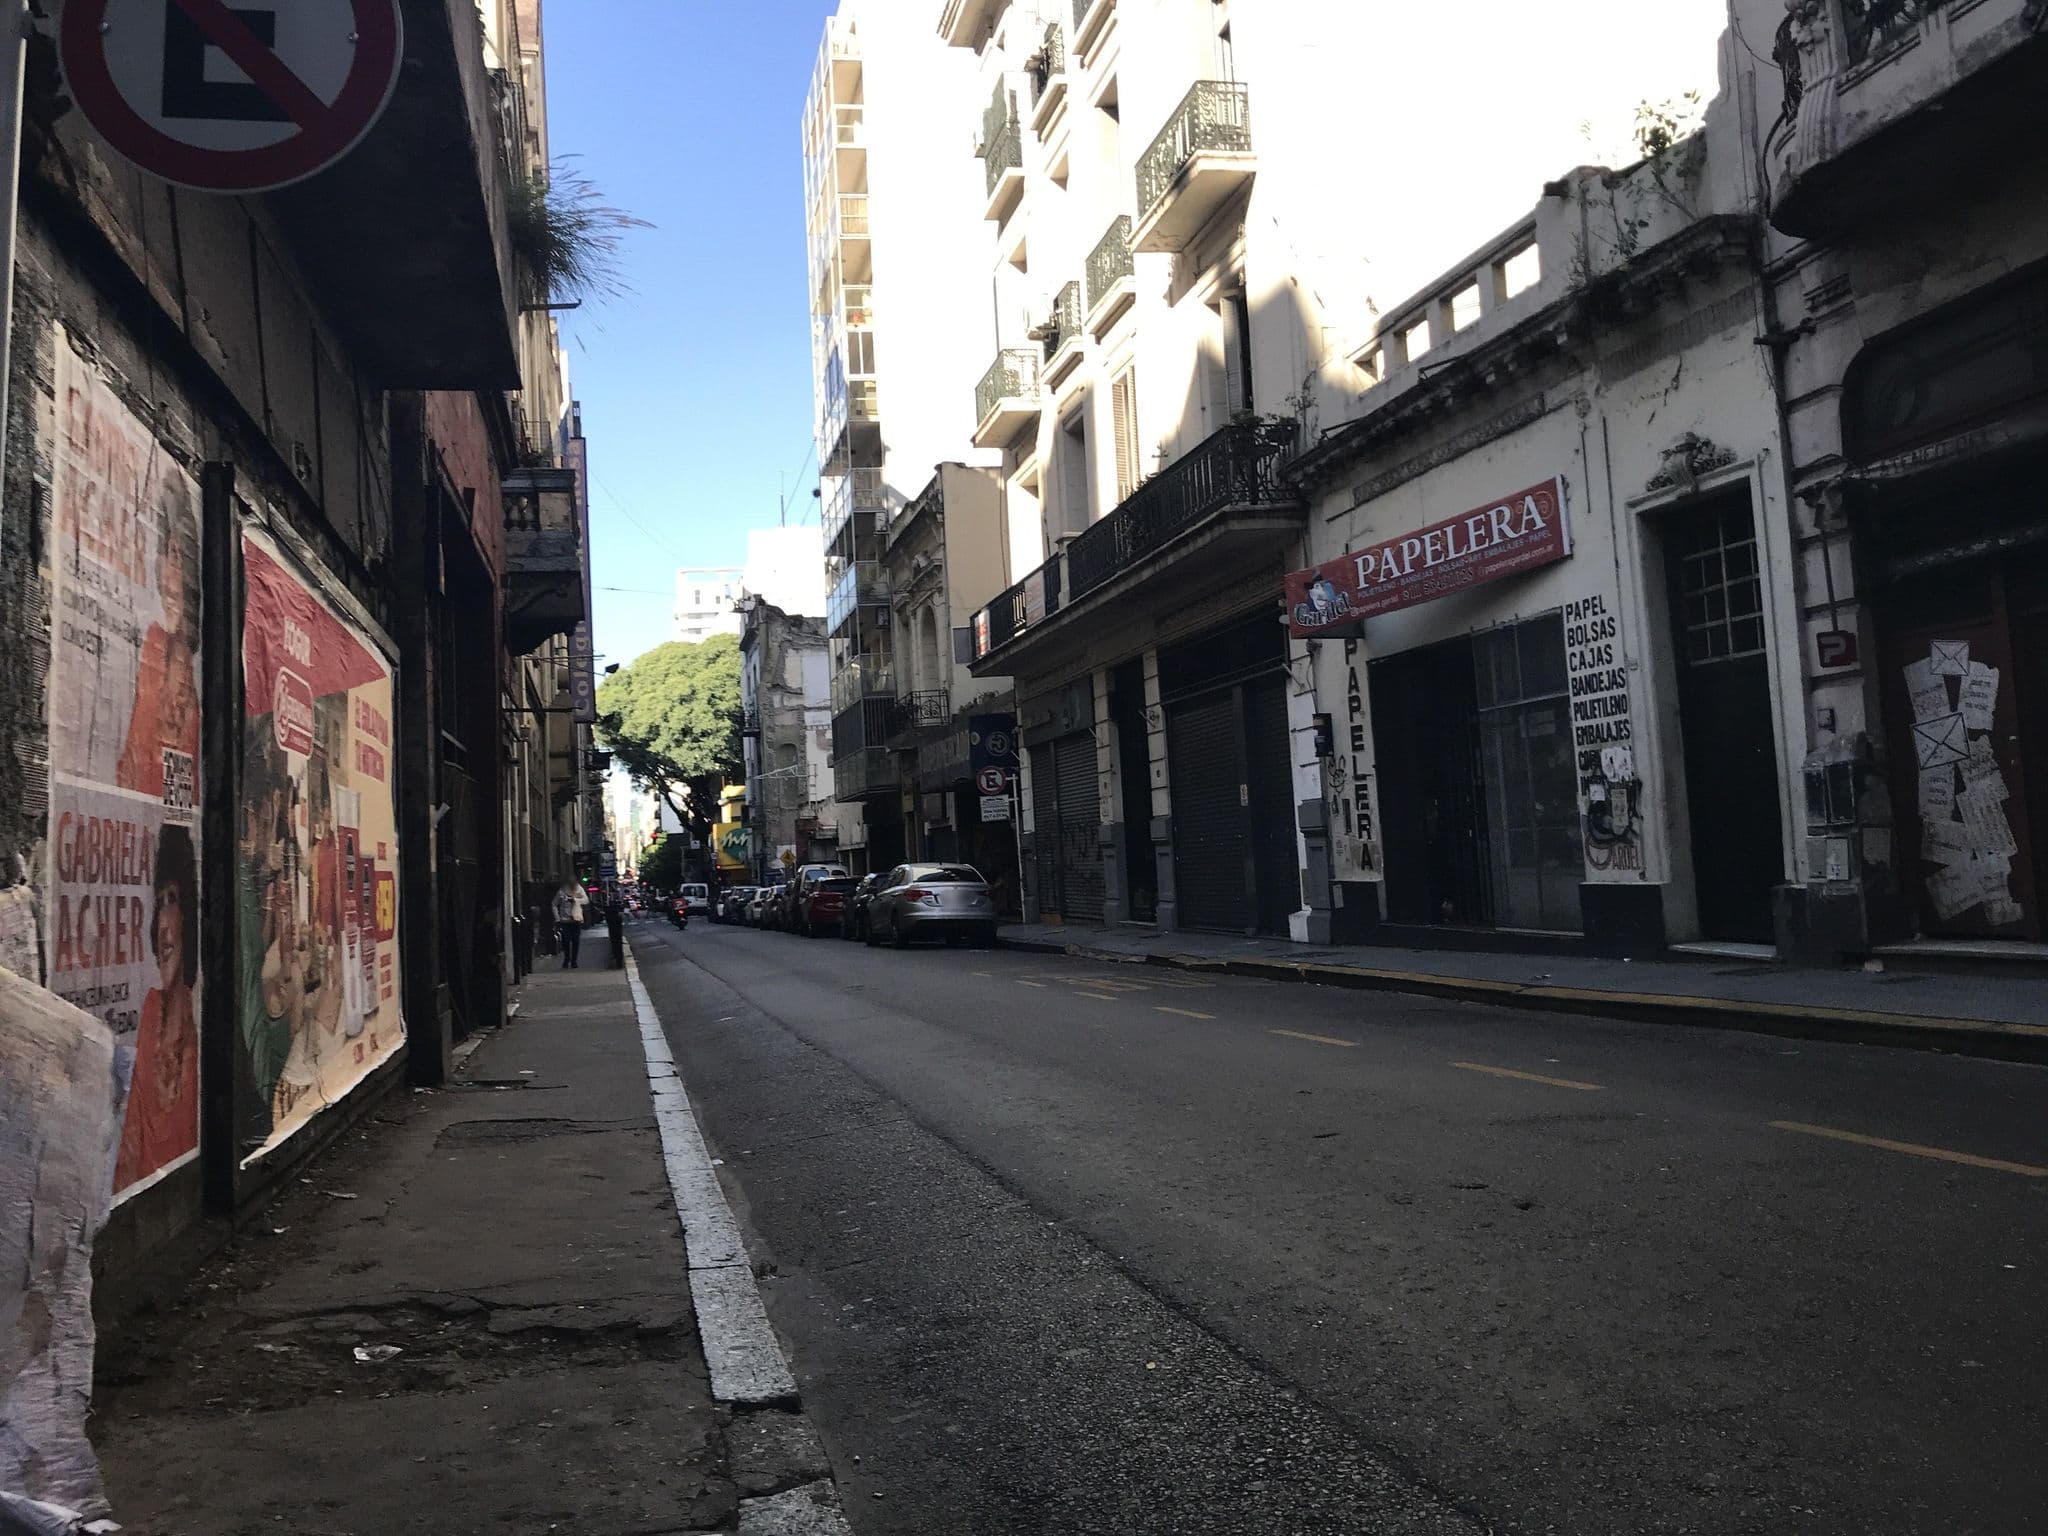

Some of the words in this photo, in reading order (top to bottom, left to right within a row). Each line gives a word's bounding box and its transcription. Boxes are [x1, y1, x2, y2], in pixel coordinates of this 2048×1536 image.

[1355, 494, 1547, 589] PAPELERA
[1566, 594, 1607, 624] PAPEL
[1567, 616, 1616, 648] BOLSAS
[573, 620, 591, 717] Colegi
[1569, 643, 1614, 672] CAJAS
[1571, 667, 1626, 697] BANDEJAS
[1573, 693, 1628, 722] POLIETILENO
[1576, 718, 1631, 747] EMBALAJES
[1344, 638, 1374, 871] PAPELERA
[56, 810, 152, 886] GABRIELA
[55, 894, 146, 973] ACHER
